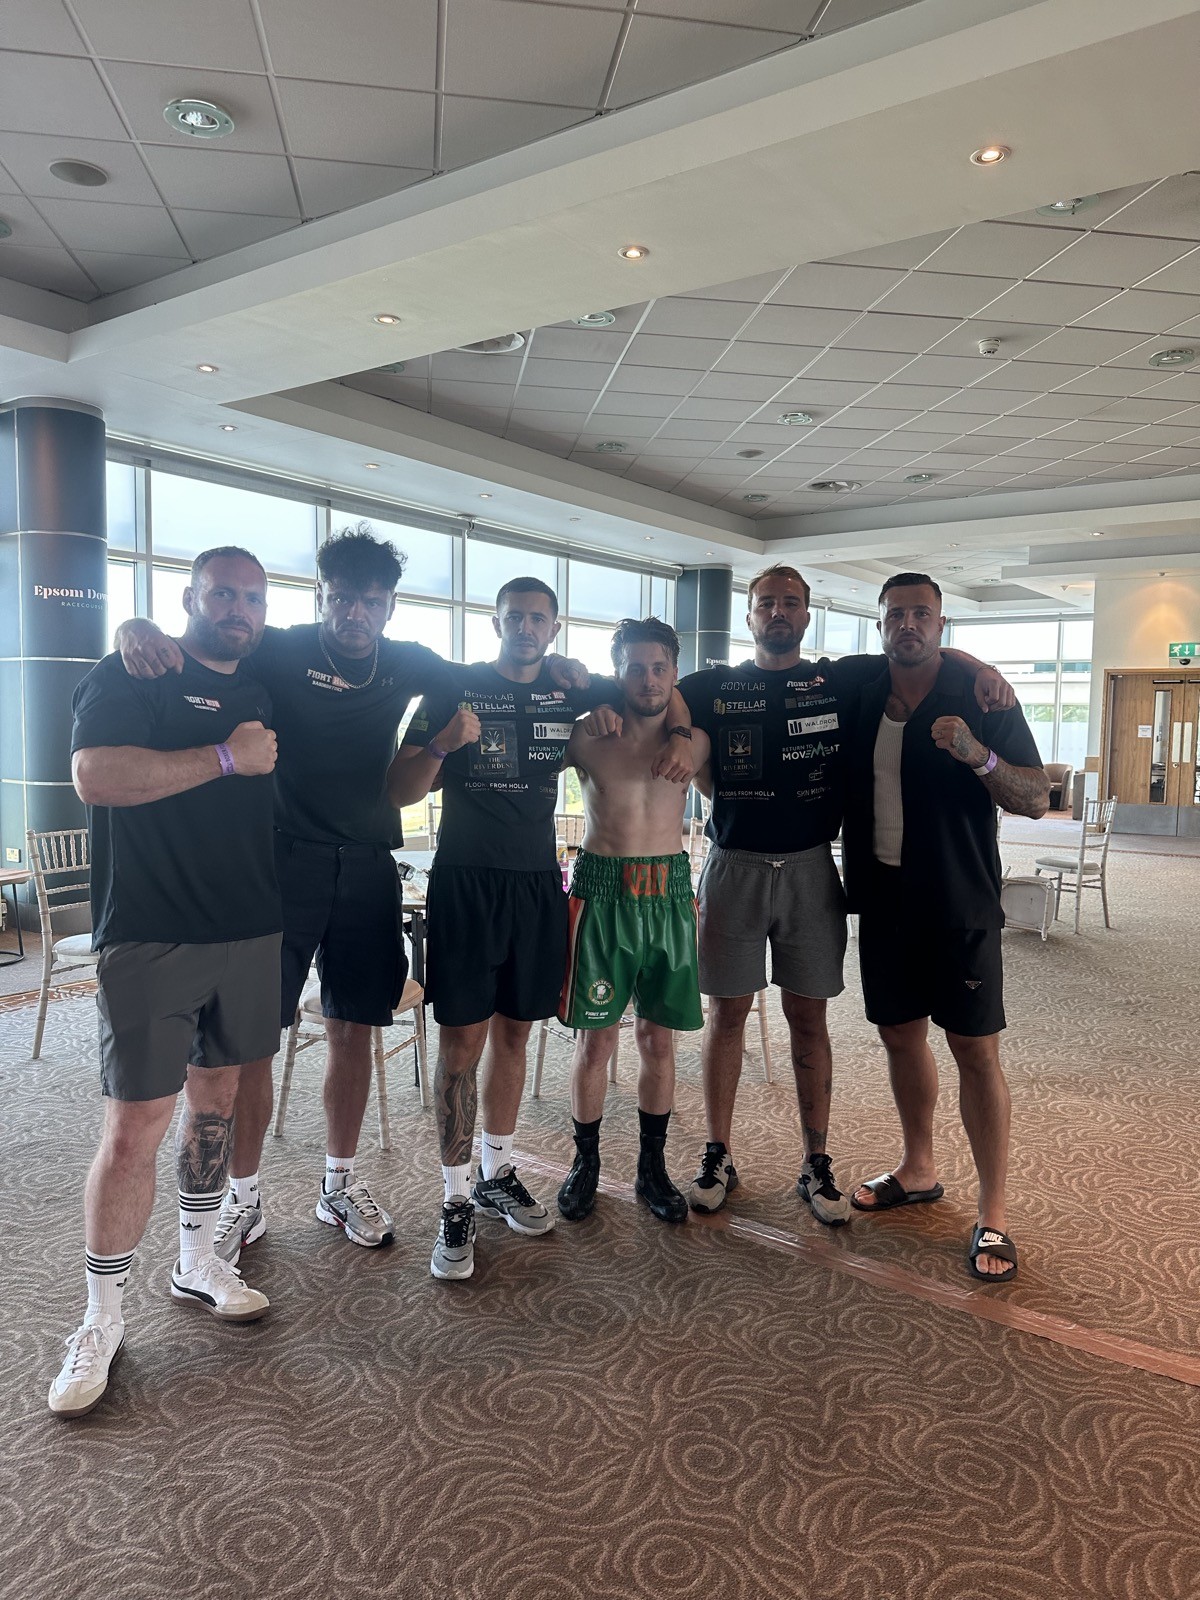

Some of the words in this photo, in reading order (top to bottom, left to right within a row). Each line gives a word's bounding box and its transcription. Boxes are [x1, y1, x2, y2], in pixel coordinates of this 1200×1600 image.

[34, 585, 84, 599] Epsom
[87, 588, 108, 600] Dow
[306, 668, 333, 683] FIGHT
[472, 701, 516, 710] STELLAR
[726, 699, 767, 710] STELLAR
[804, 718, 837, 727] WALDRON
[528, 745, 566, 761] MOVEM
[983, 1231, 1004, 1242] NIKE
